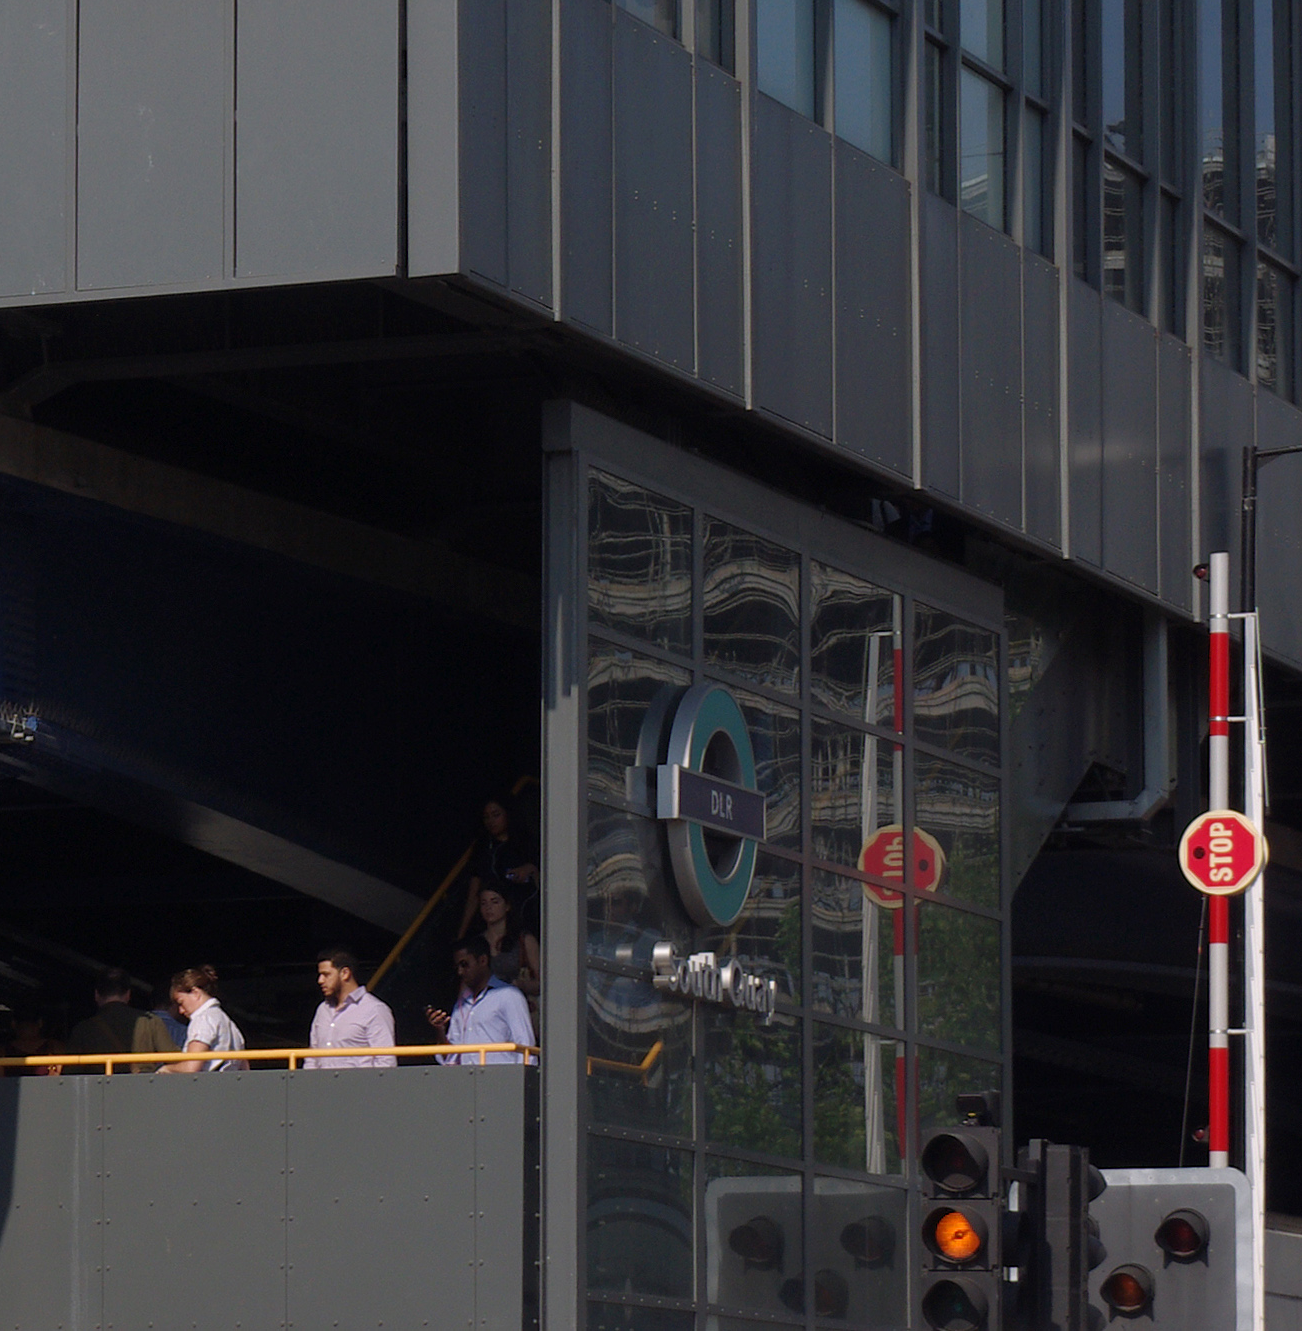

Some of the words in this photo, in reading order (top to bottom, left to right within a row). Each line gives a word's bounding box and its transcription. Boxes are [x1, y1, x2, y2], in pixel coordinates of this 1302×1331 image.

[711, 789, 733, 820] DLR
[1209, 822, 1233, 882] STOP
[652, 941, 723, 1002] South
[721, 957, 777, 1026] Quay
